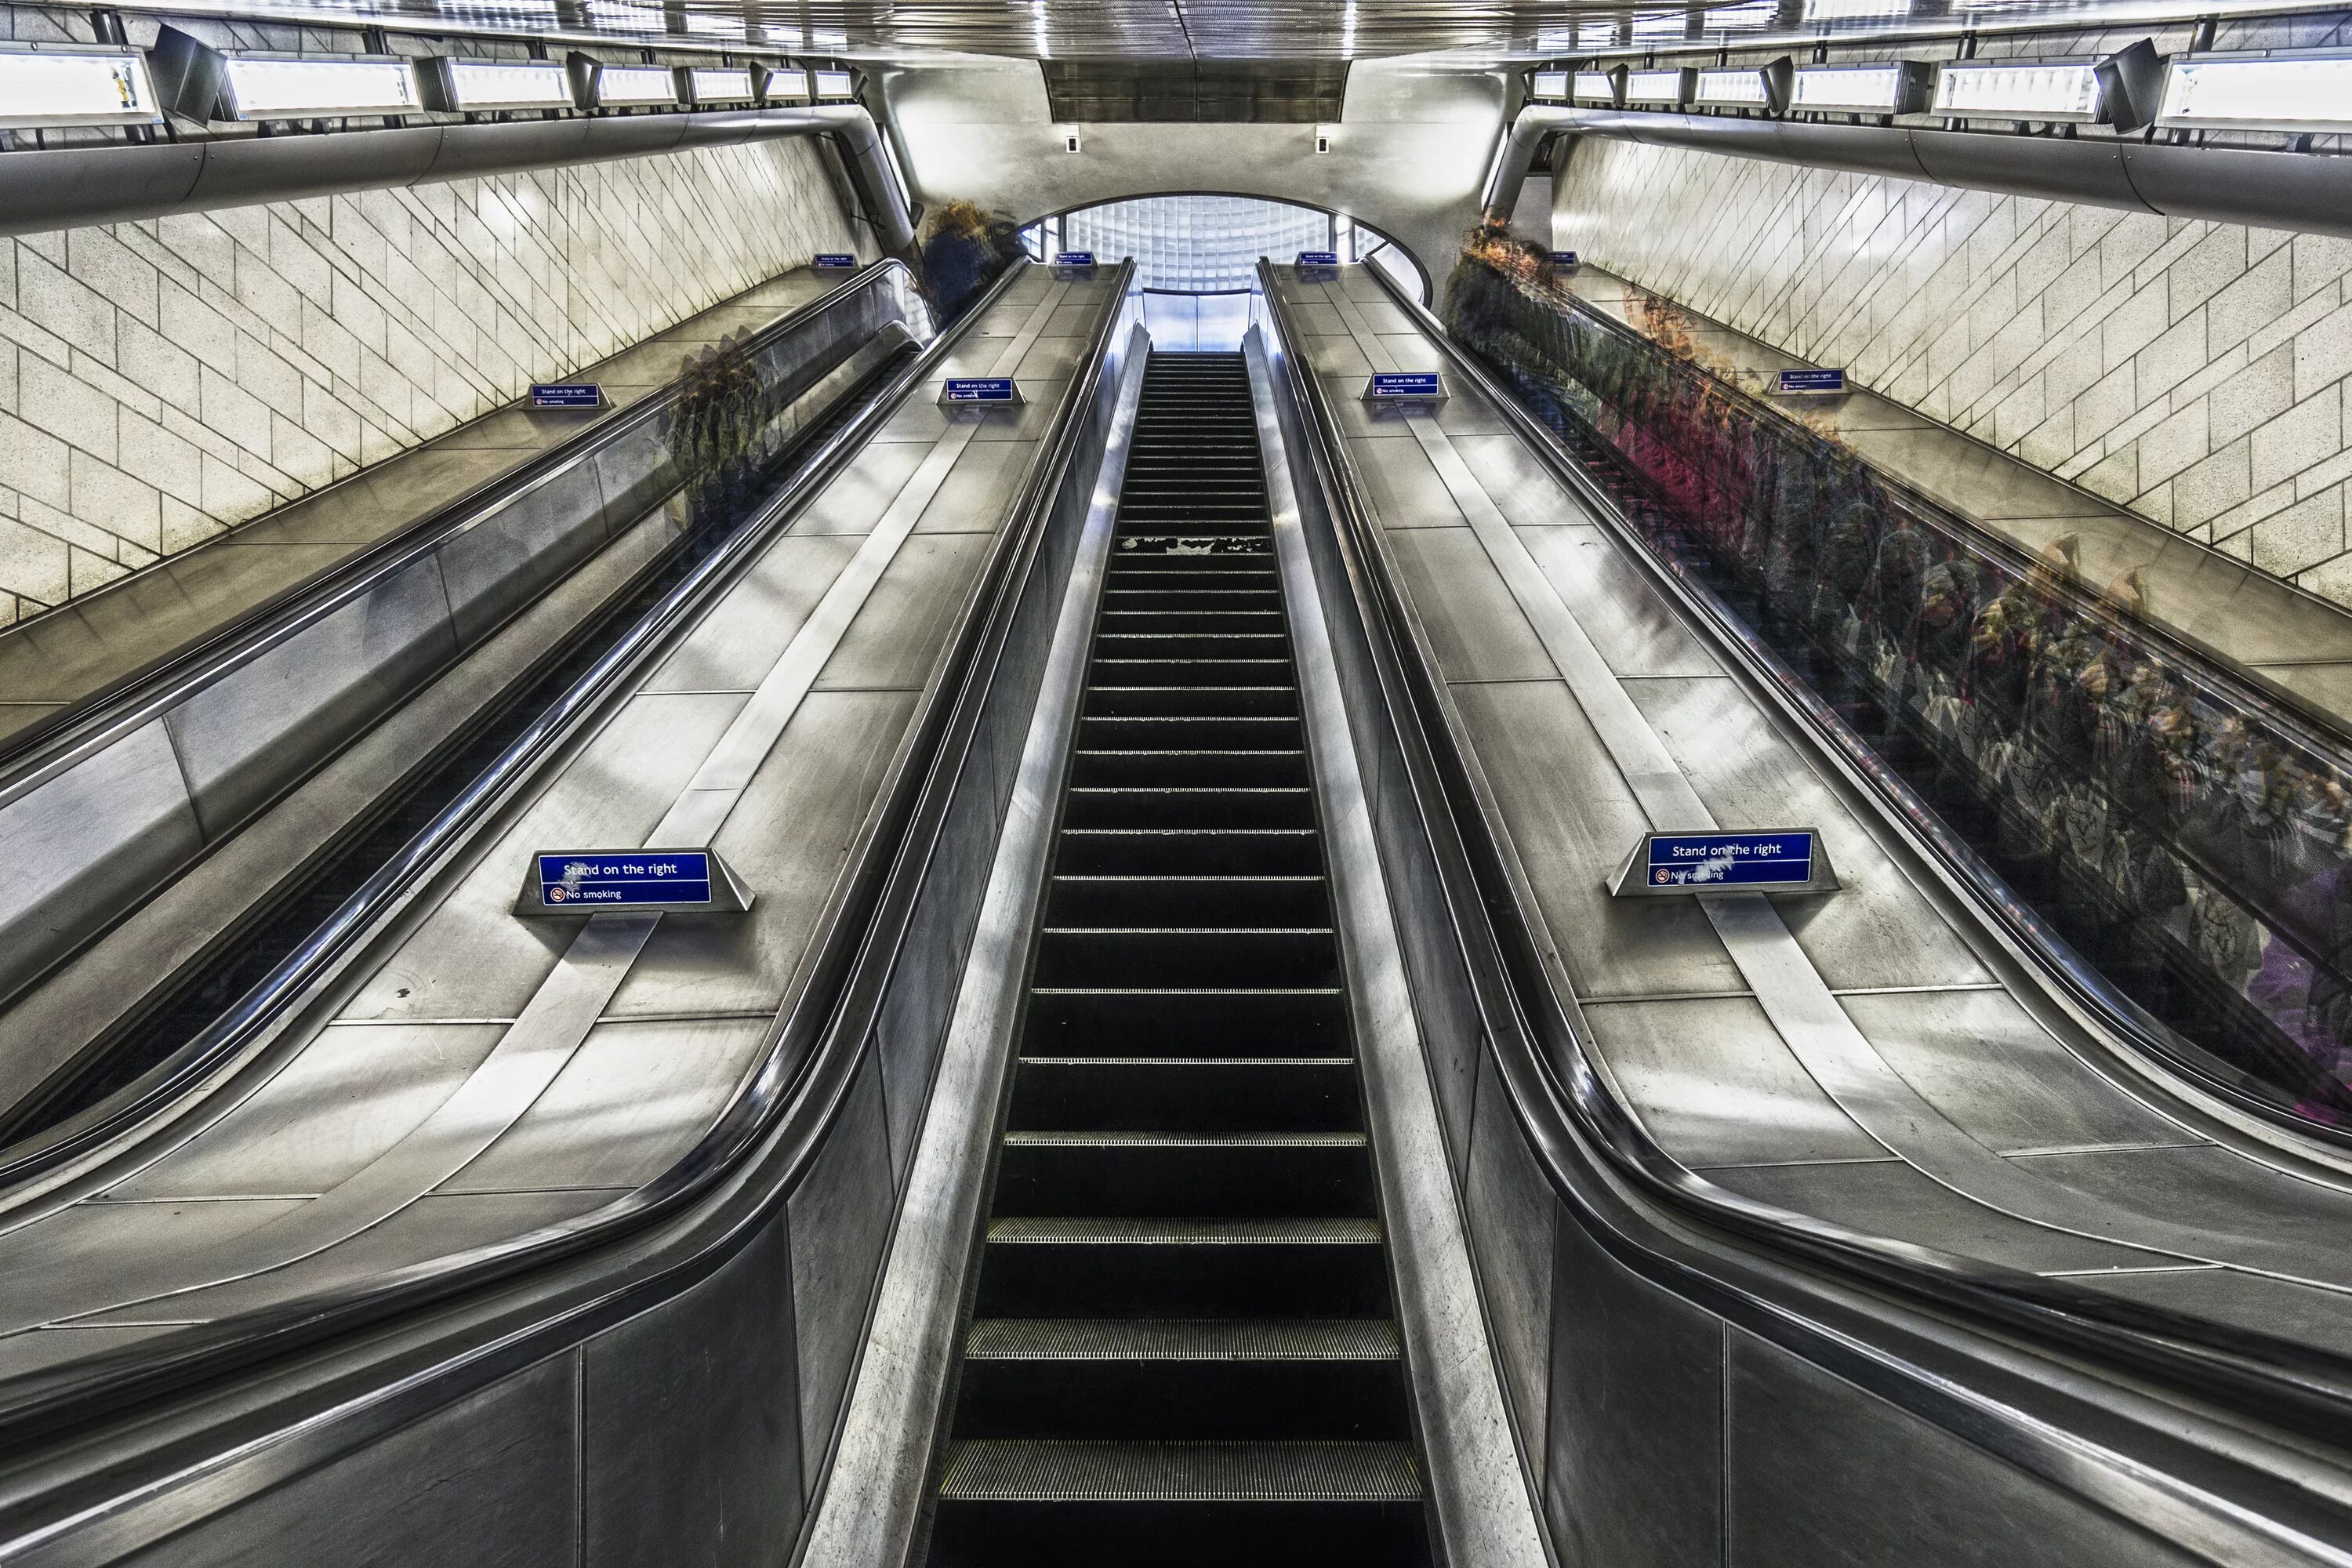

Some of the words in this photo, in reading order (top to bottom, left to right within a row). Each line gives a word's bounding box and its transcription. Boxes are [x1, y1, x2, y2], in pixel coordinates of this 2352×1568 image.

[1673, 846, 1706, 856] Stand
[1754, 844, 1781, 856] right
[564, 864, 599, 875] Stand
[604, 866, 619, 875] on
[623, 864, 644, 874] the
[649, 863, 677, 876] right
[1687, 871, 1724, 880] sming
[584, 890, 621, 899] smoking
